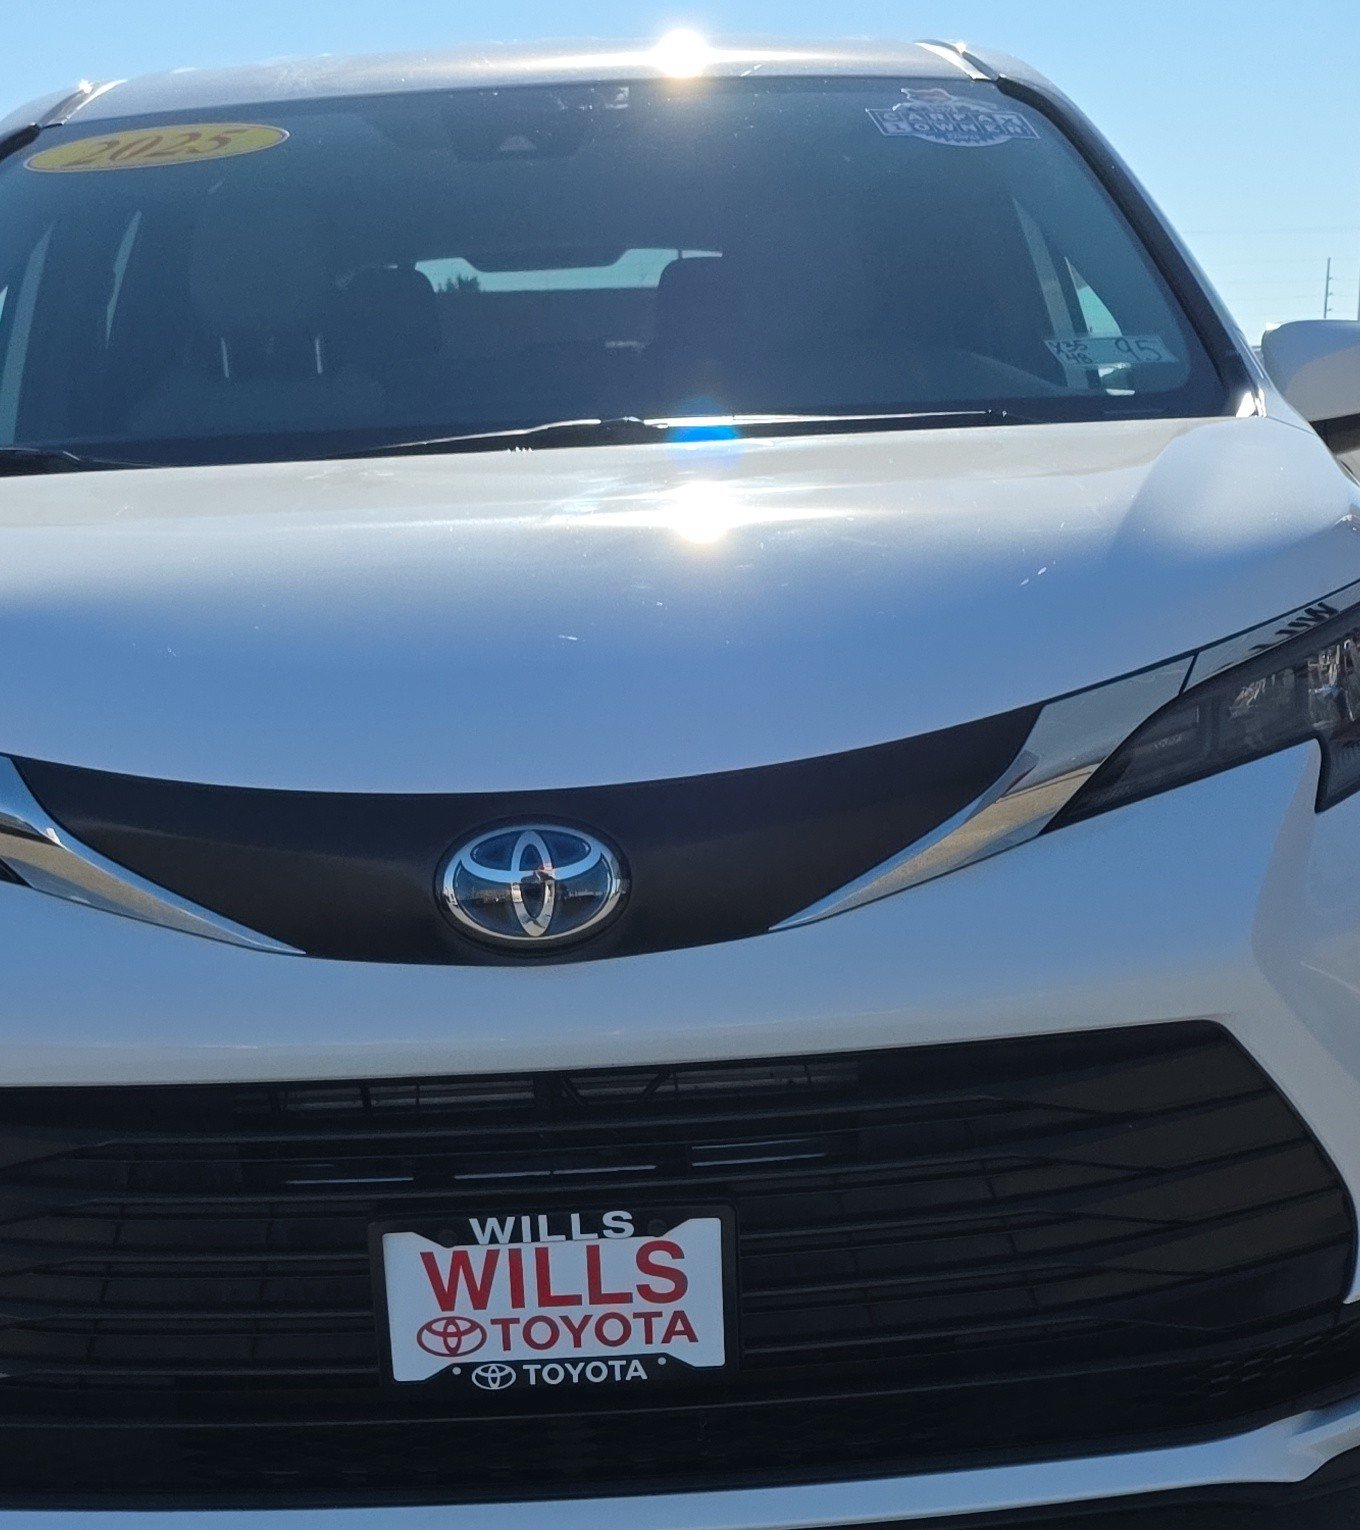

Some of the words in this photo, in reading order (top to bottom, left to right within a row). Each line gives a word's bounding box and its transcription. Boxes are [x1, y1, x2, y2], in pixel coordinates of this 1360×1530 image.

[62, 129, 250, 167] 2025
[468, 1210, 635, 1245] WILLS
[419, 1240, 689, 1312] WILLS
[490, 1310, 699, 1352] TOYOTA
[522, 1359, 648, 1386] TOYOTA
